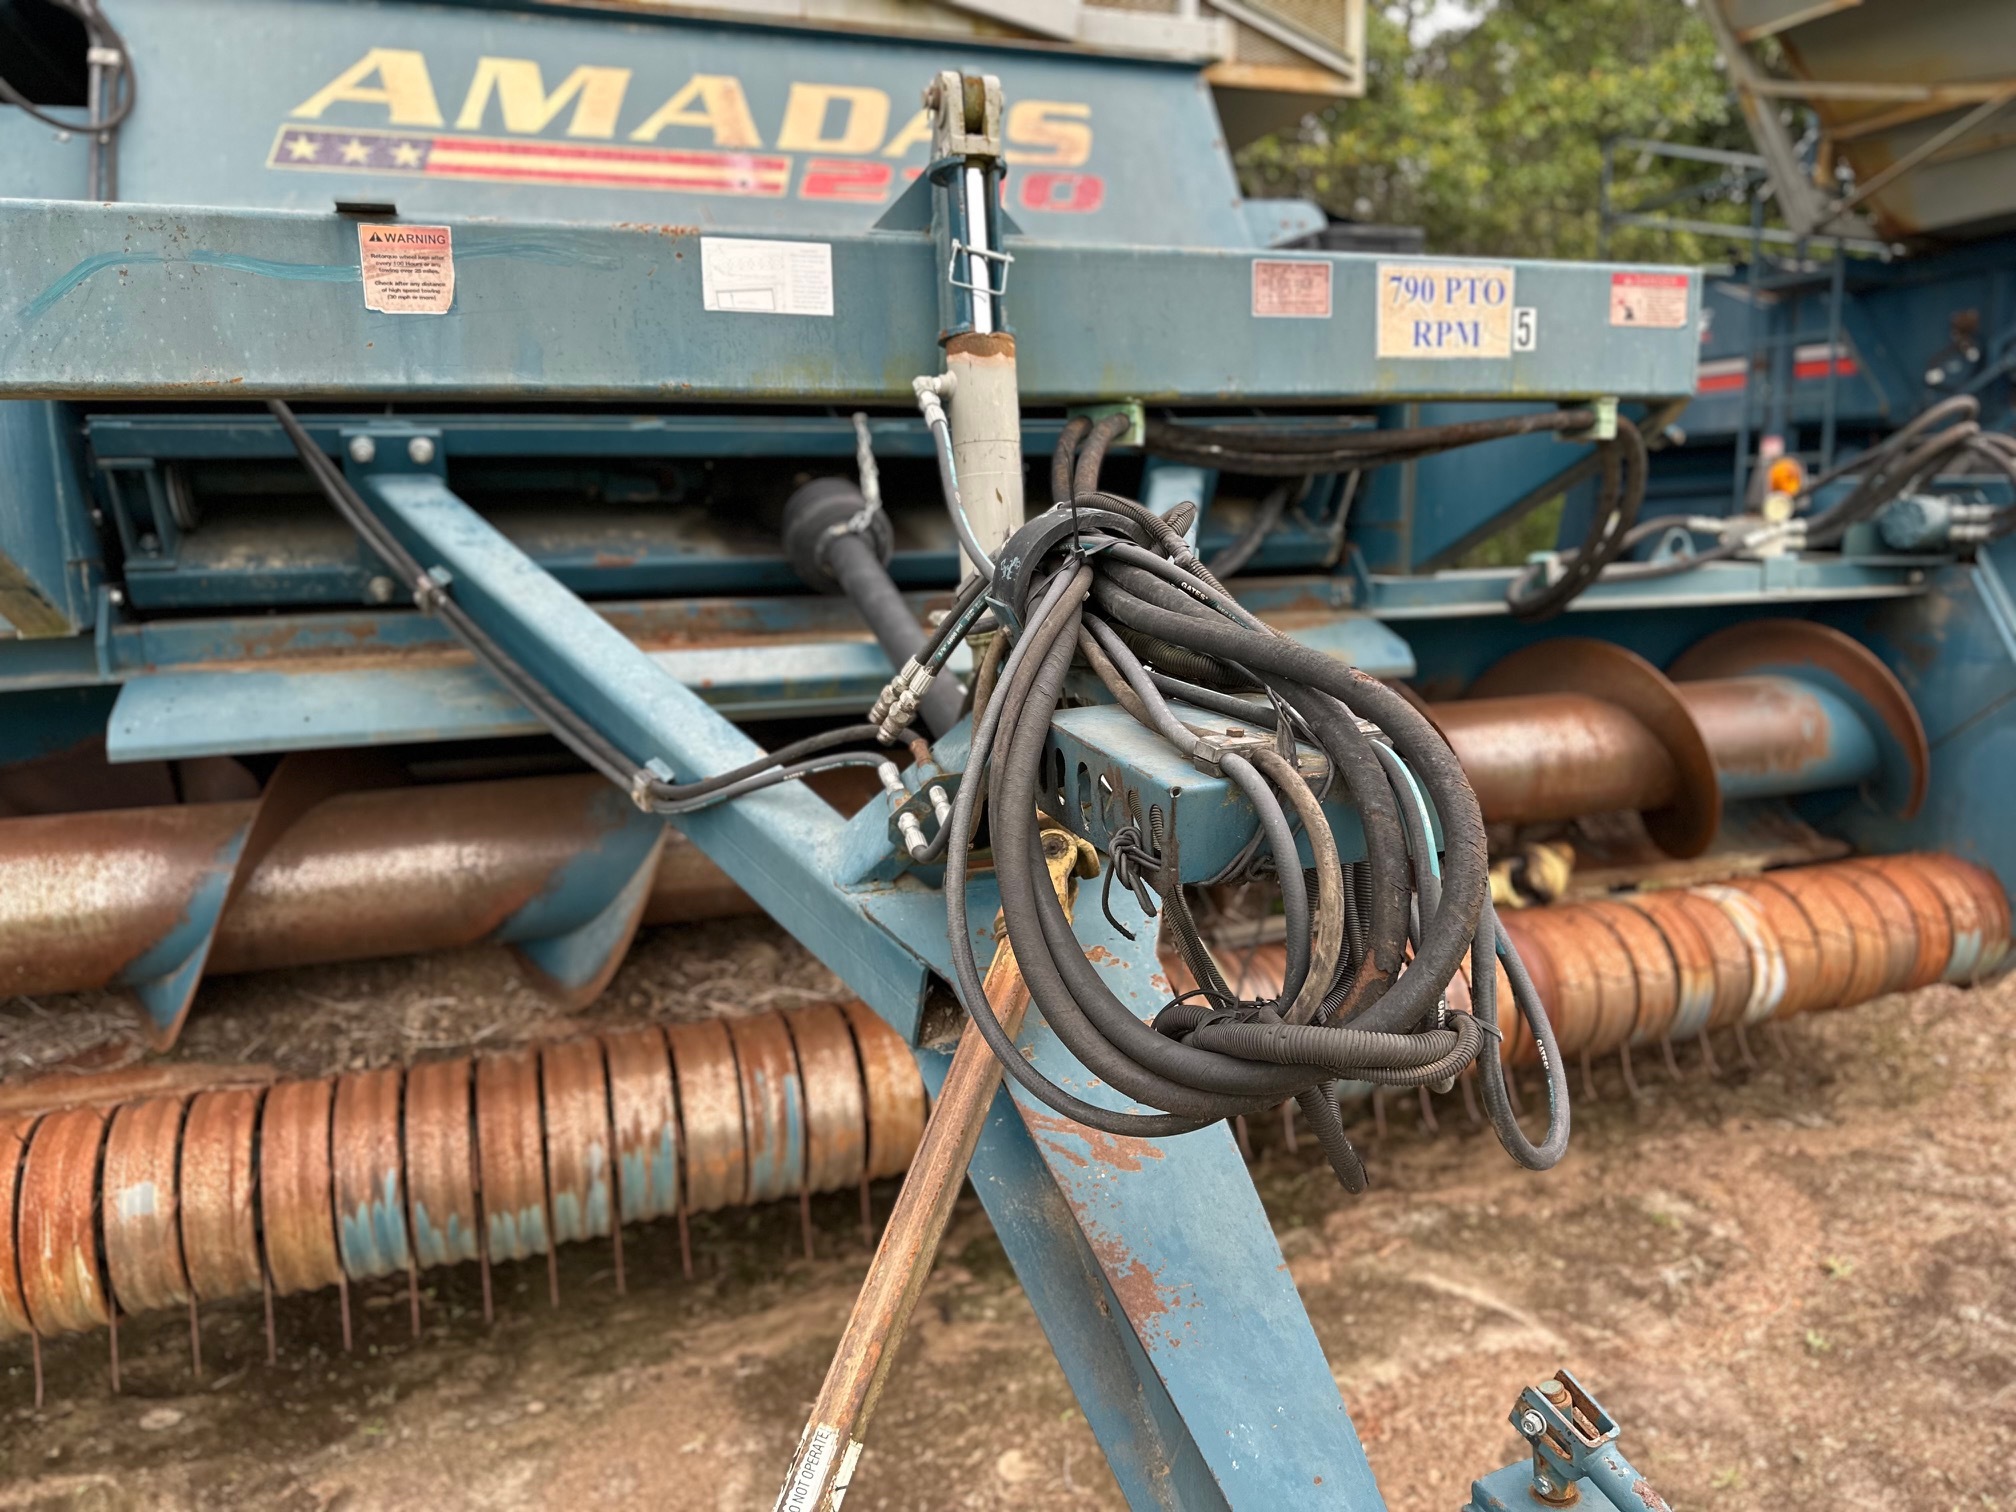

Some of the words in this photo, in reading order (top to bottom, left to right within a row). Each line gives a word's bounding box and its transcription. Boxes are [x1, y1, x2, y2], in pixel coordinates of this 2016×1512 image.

[797, 158, 1107, 214] 20
[384, 233, 446, 245] WARNING
[1389, 275, 1436, 305] 790
[1445, 276, 1507, 307] PTO
[1413, 319, 1481, 347] RPM
[1518, 310, 1531, 347] 5
[792, 1479, 811, 1504] NOT
